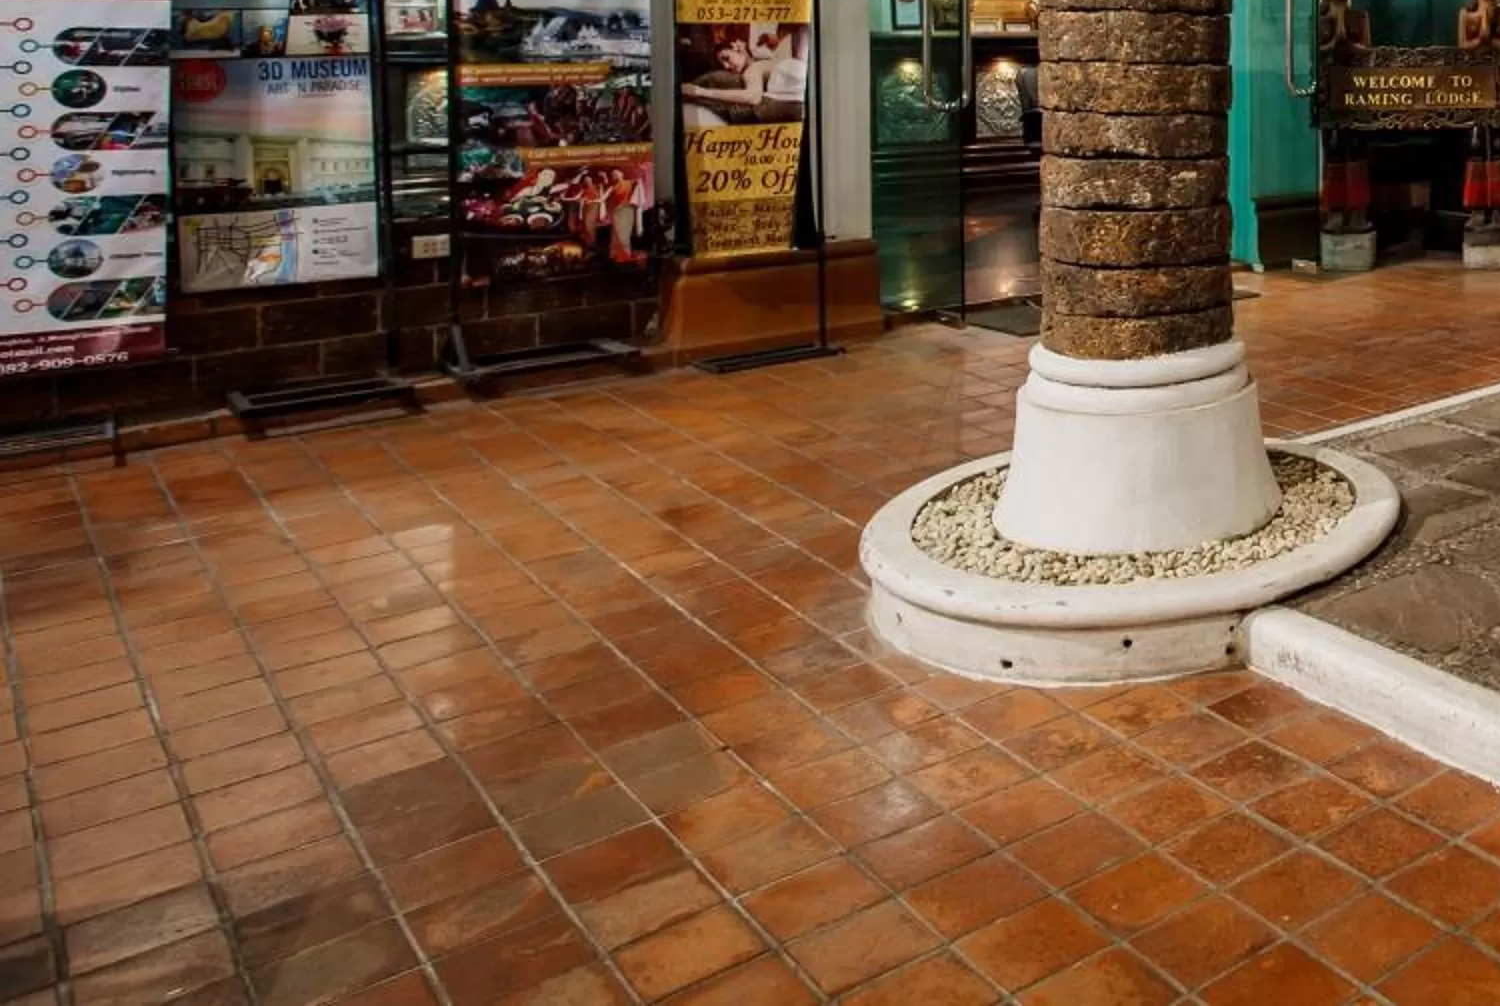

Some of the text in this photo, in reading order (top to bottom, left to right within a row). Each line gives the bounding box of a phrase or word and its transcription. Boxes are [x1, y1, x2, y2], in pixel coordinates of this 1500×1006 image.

[258, 58, 367, 81] 3D MUSEUM
[1352, 74, 1473, 89] WELCOME TO
[1344, 91, 1482, 106] RAMING LODGE
[686, 129, 753, 160] Happy
[695, 168, 752, 193] 20%
